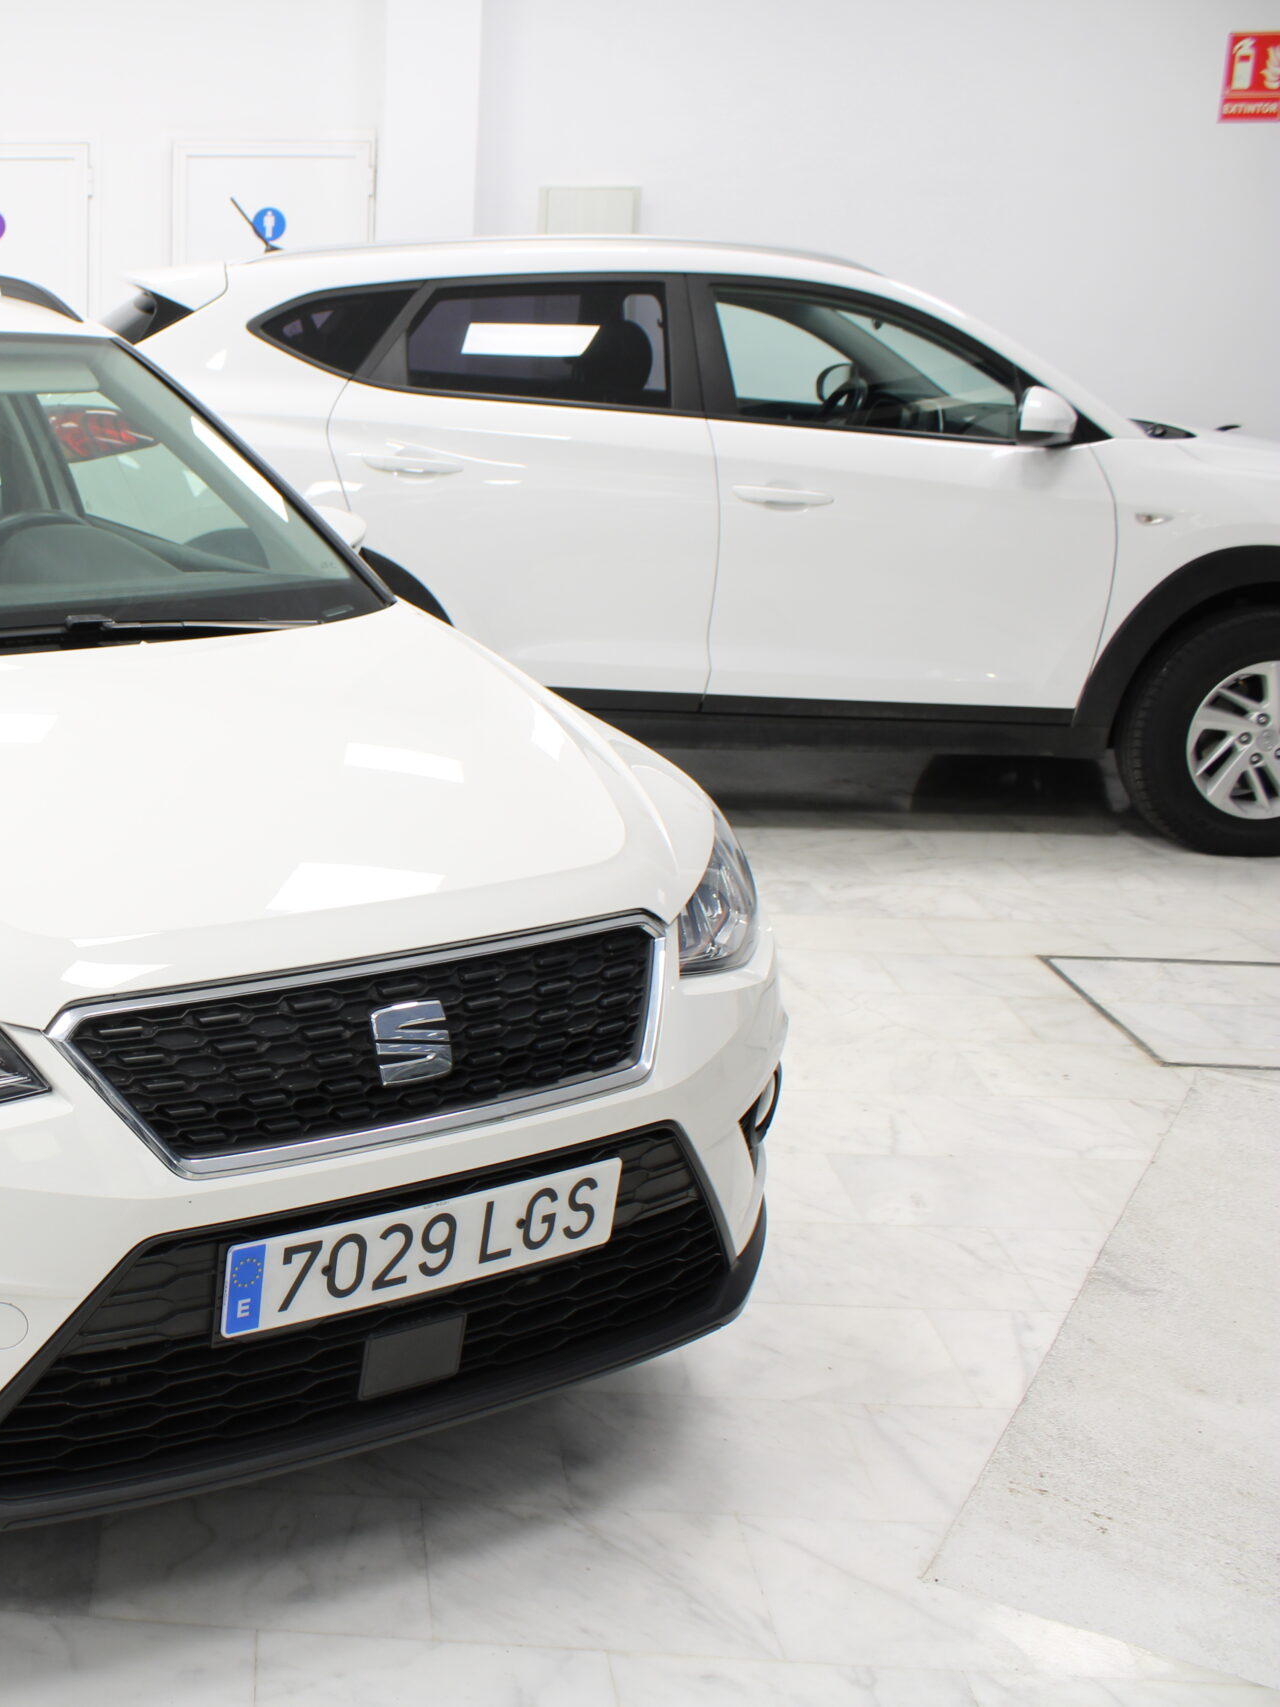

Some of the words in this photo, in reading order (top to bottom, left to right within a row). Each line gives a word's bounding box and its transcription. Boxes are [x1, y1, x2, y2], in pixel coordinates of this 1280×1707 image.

[236, 1298, 251, 1318] E
[277, 1212, 457, 1313] 7029
[479, 1177, 598, 1264] LGS
